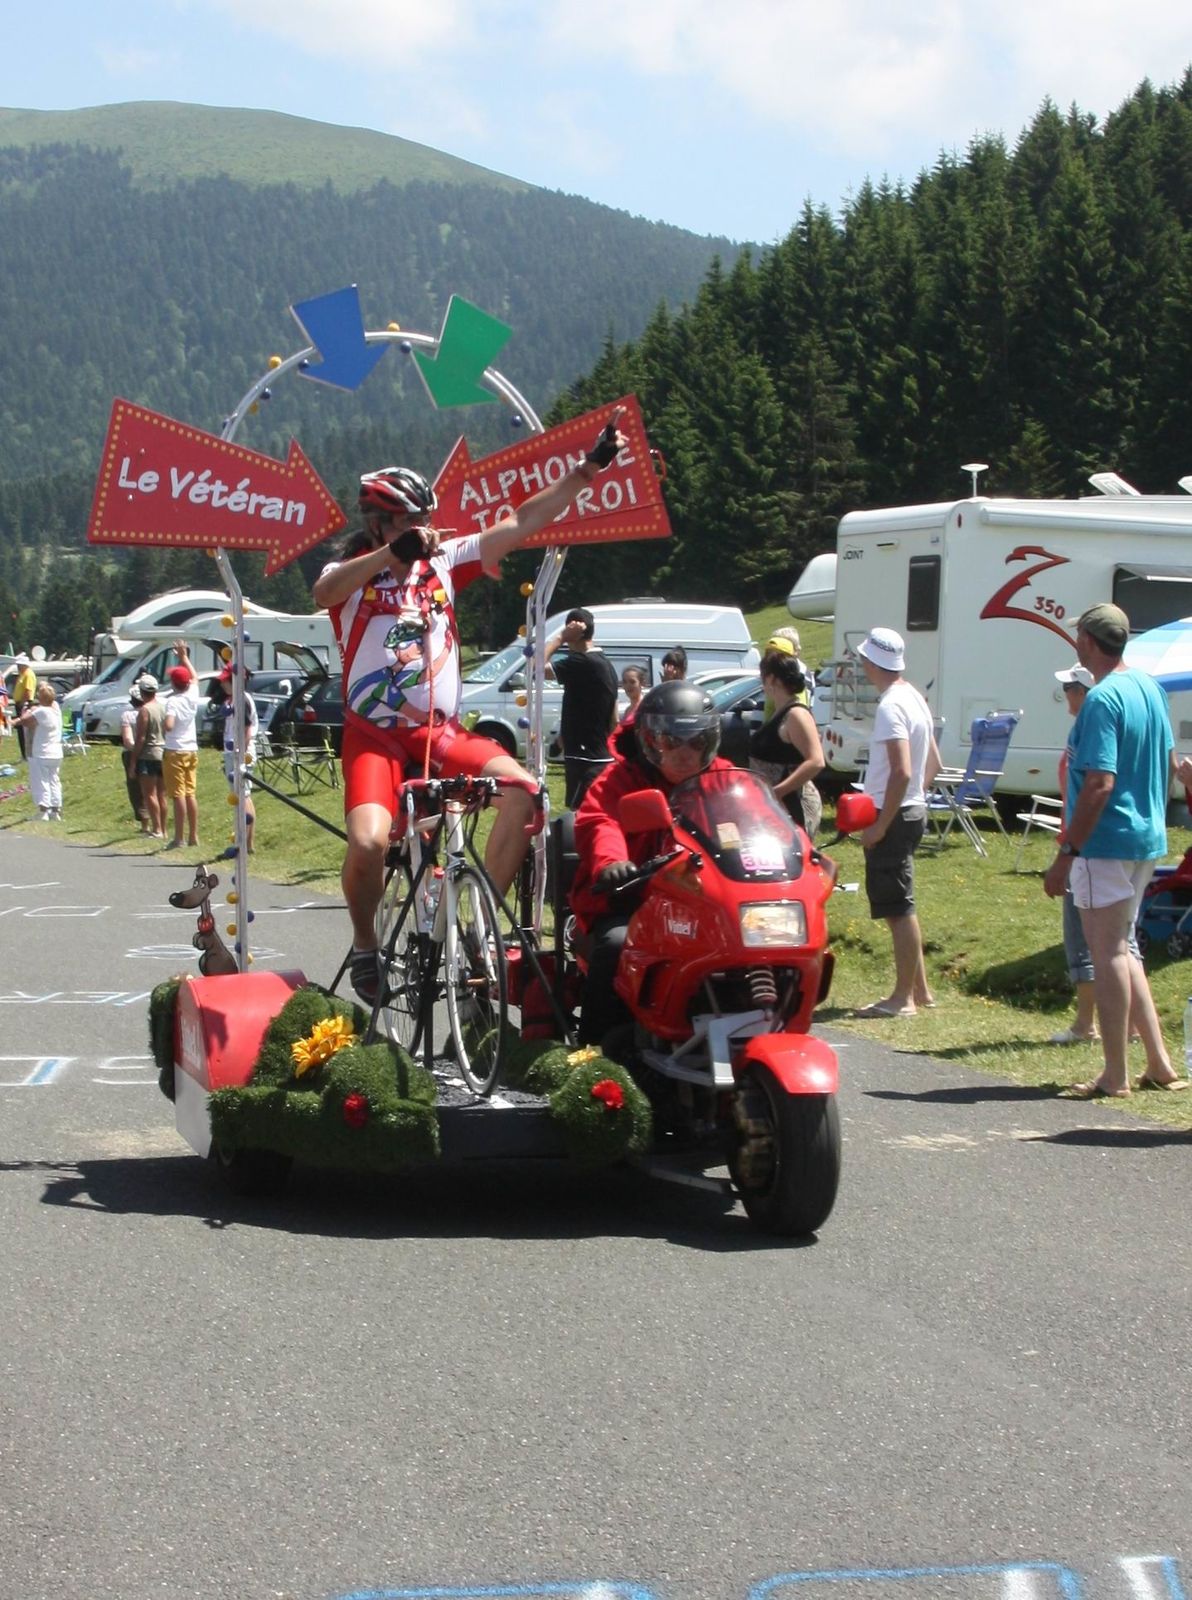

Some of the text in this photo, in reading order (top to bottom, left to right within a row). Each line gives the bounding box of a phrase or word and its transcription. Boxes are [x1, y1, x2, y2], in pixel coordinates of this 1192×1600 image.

[118, 457, 306, 525] Le Vétéran
[460, 447, 636, 511] ALPHONE
[471, 477, 638, 534] TOROI
[1034, 596, 1065, 620] 350
